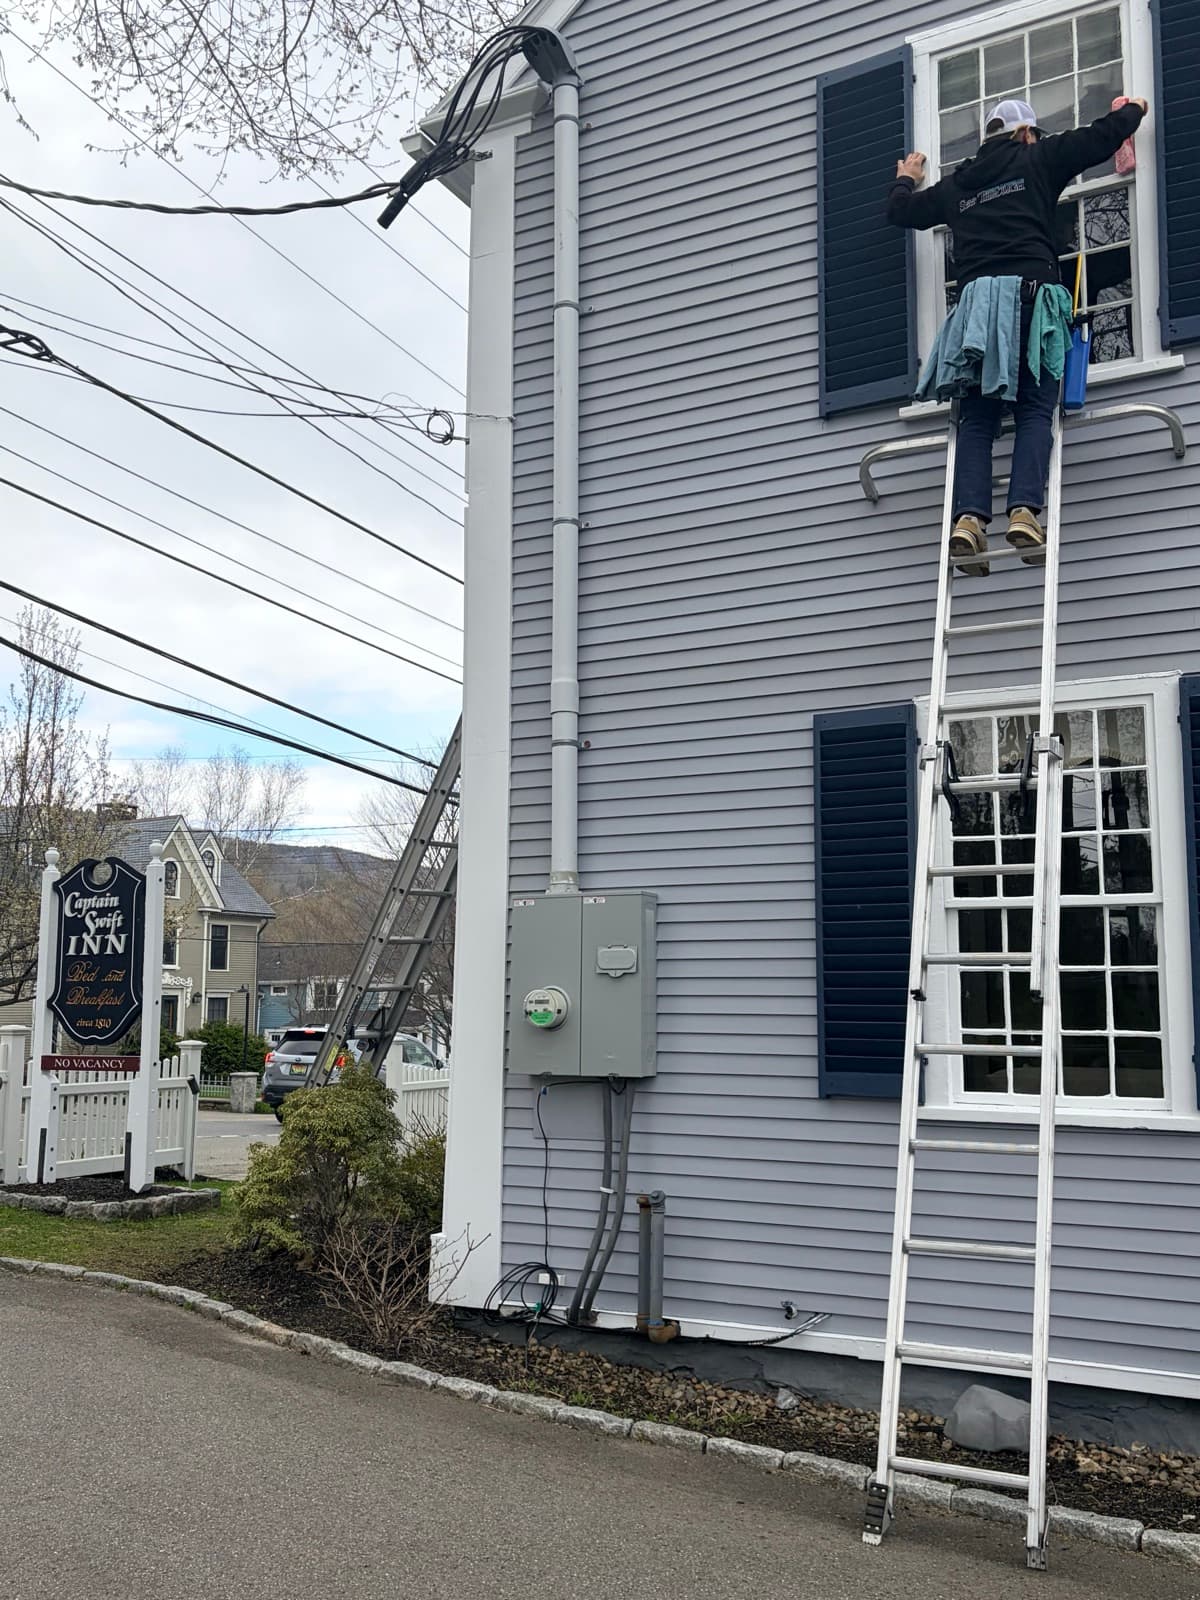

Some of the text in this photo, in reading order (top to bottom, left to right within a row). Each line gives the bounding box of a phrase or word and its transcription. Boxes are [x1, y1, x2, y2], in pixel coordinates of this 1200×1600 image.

[64, 892, 120, 918] Captain
[84, 910, 124, 936] Swift
[65, 933, 128, 956] INN
[65, 961, 126, 982] Bed and
[65, 986, 125, 1010] Breakfast
[76, 1018, 112, 1029] circa 1810
[54, 1057, 125, 1069] NO VACANCY
